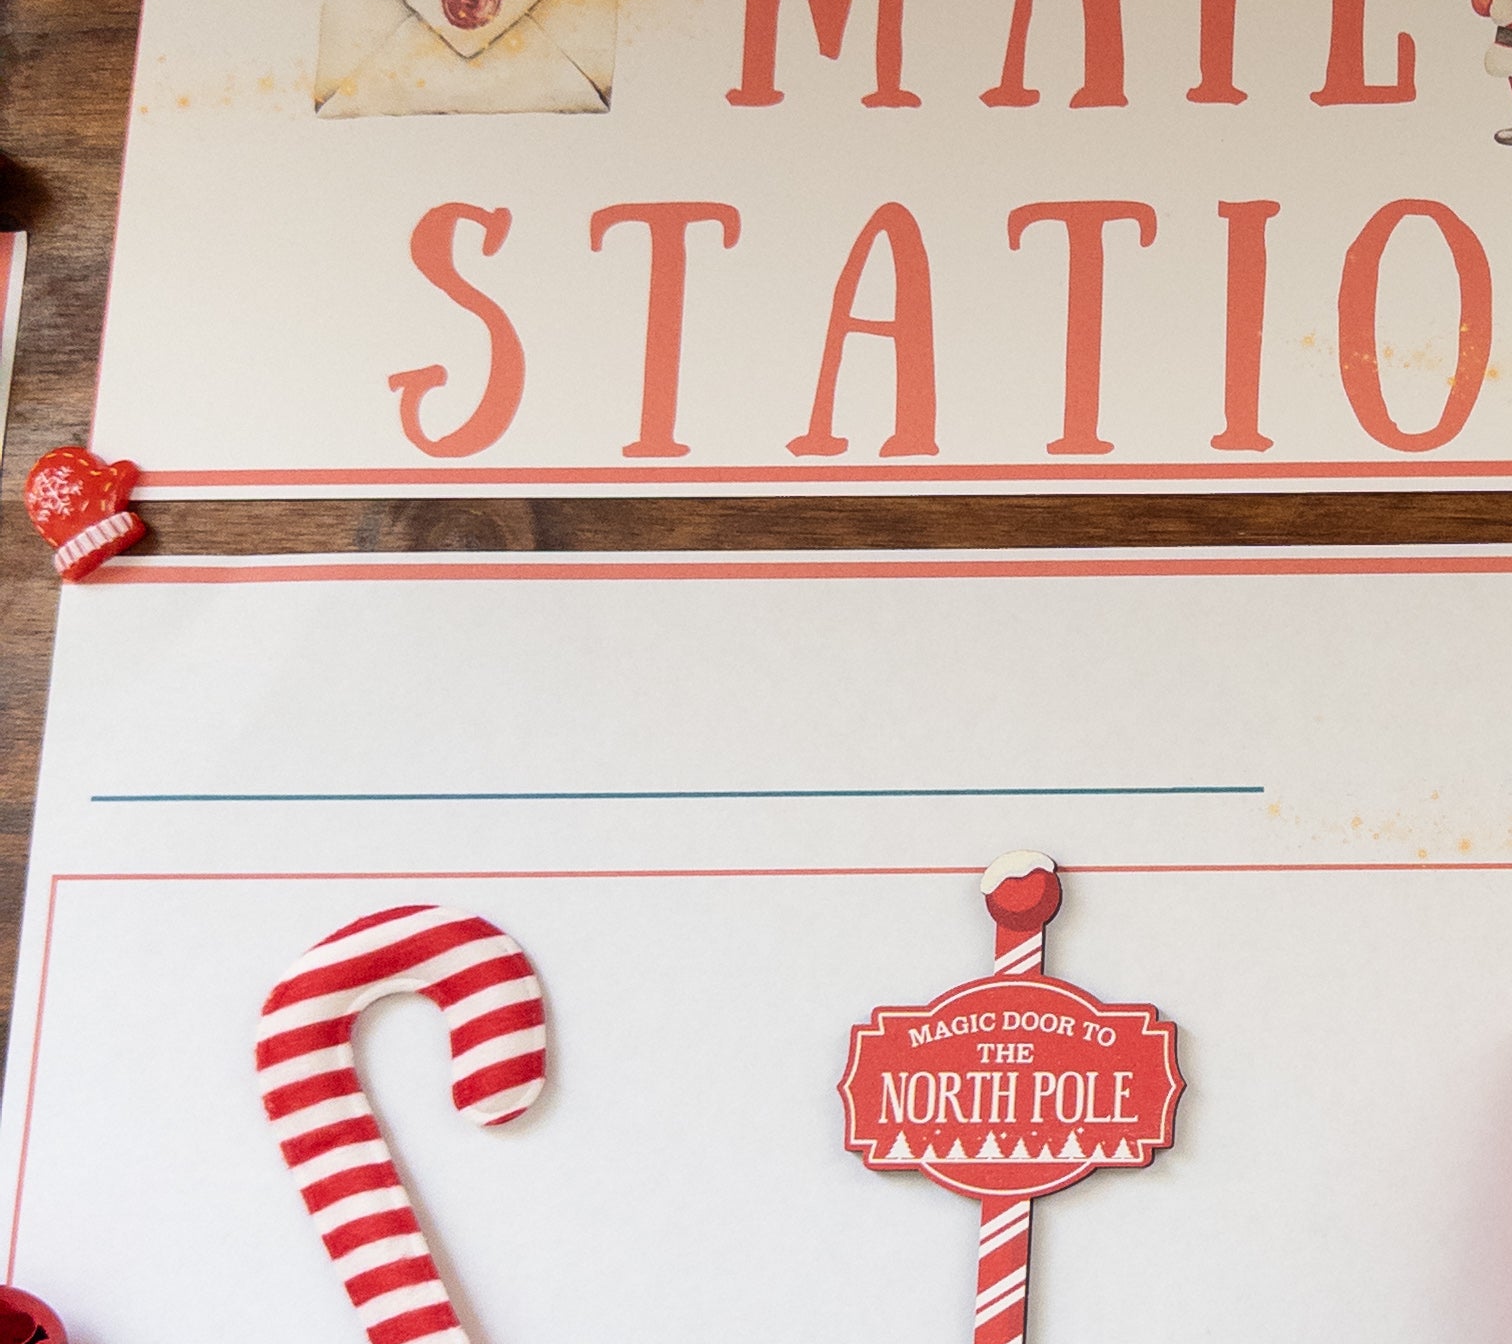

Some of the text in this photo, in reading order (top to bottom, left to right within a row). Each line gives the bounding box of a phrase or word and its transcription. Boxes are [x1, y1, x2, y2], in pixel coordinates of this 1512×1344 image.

[907, 1011, 1117, 1048] MAGIC DOOR TO
[977, 1043, 1034, 1063] THE
[878, 1071, 1139, 1124] NORTH POLE
